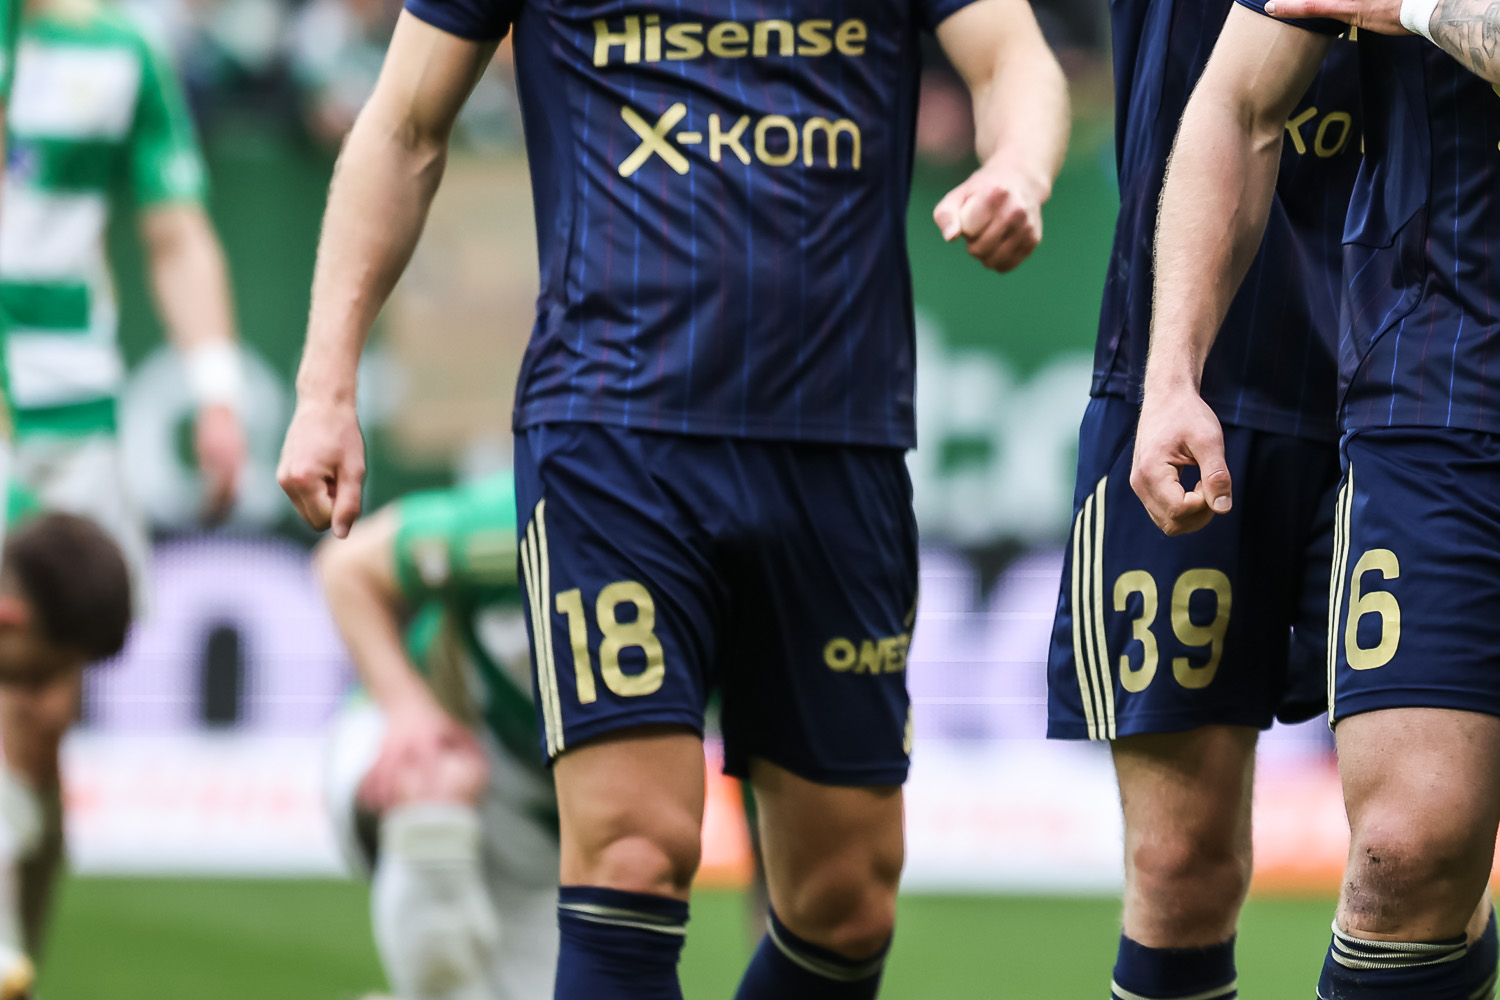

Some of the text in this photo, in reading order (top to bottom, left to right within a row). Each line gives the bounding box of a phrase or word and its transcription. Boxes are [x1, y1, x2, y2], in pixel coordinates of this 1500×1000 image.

[593, 14, 868, 67] Hisense
[555, 580, 665, 704] 18
[1113, 568, 1233, 693] 39
[1344, 548, 1401, 671] 6
